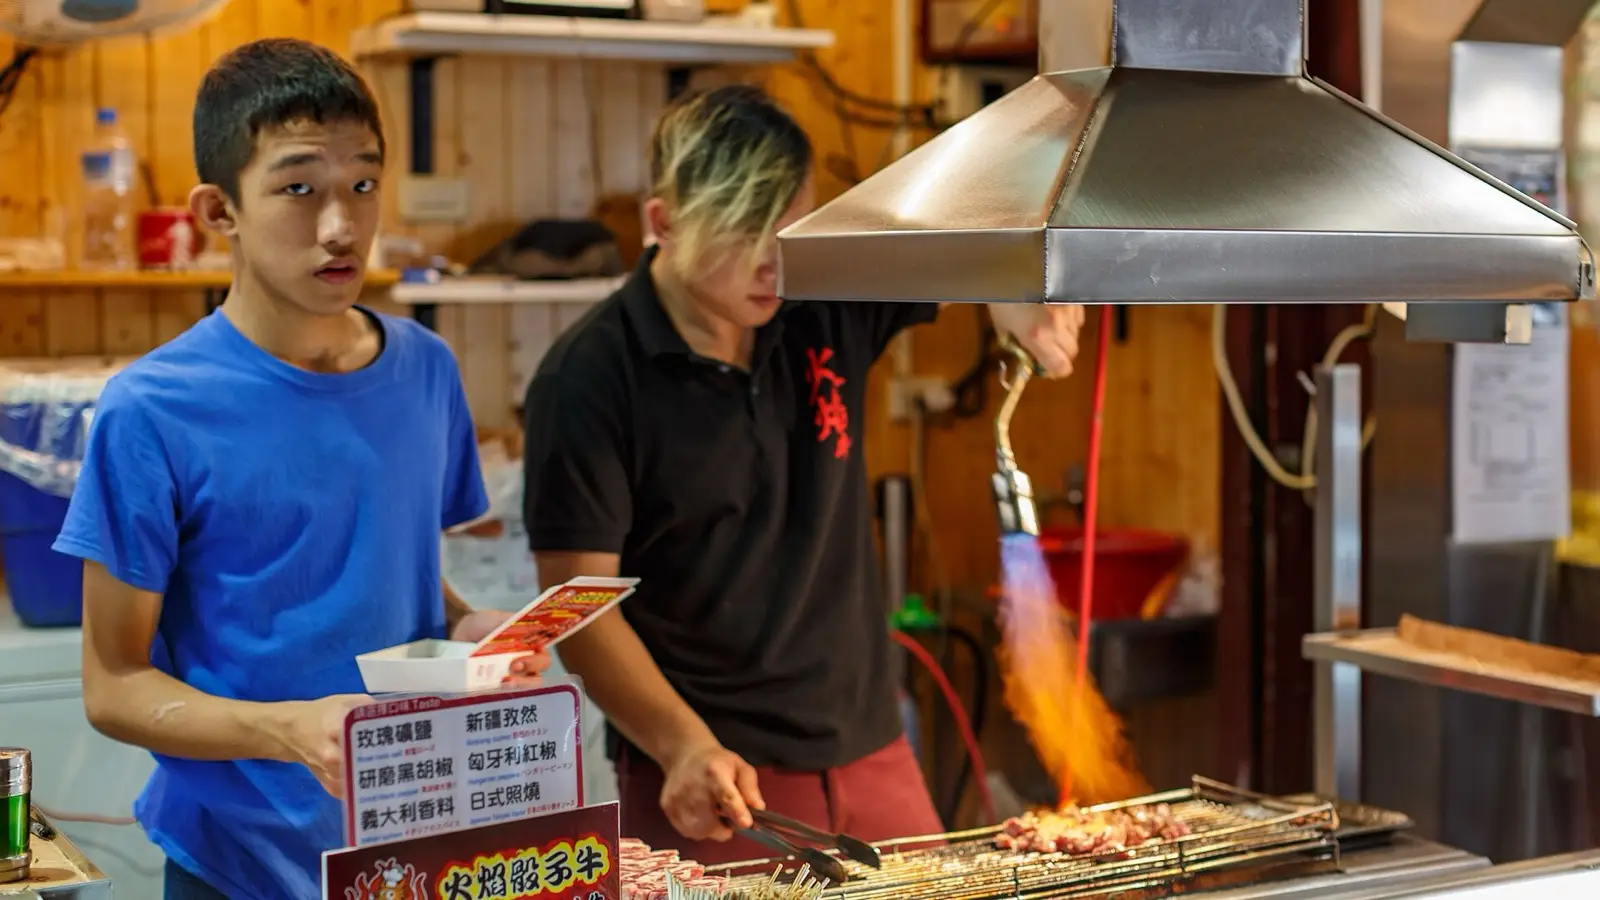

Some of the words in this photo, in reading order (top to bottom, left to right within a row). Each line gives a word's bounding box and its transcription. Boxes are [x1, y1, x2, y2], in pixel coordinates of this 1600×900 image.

[466, 704, 538, 732] 新疆孜然
[357, 720, 432, 748] 玫瑰礦鹽
[468, 741, 557, 771] 匈牙利紅椒
[359, 757, 453, 790] 研磨黑胡椒
[471, 781, 541, 811] 日式照燒
[361, 796, 455, 831] 義大利香料
[445, 845, 604, 900] 火焰骰子牛
